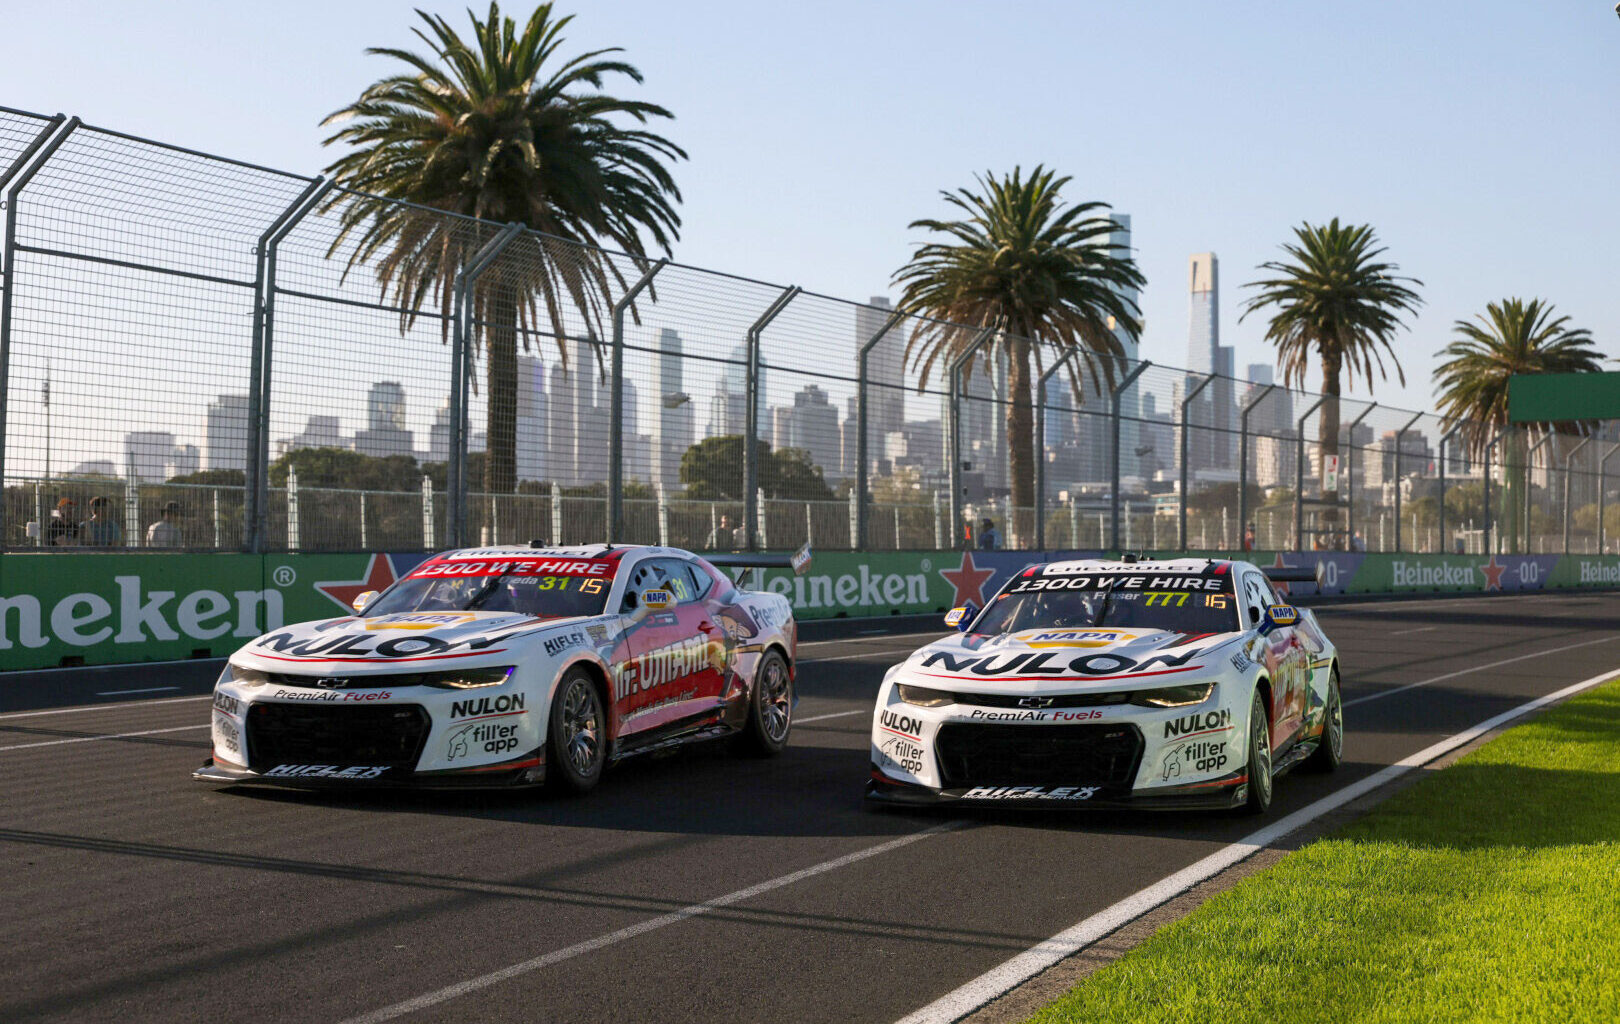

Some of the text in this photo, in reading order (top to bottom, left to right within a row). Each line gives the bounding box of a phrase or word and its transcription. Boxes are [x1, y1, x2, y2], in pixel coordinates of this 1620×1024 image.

[414, 561, 610, 577] 1300 WE HIRE
[1391, 561, 1475, 587] Heineken
[499, 576, 538, 585] Oeda
[539, 576, 571, 591] 31
[672, 578, 689, 600] 31
[731, 564, 930, 609] Heineken
[1010, 576, 1223, 593] 1300 WE HIRE
[646, 592, 667, 603] NAPA
[1093, 591, 1141, 601] Frser
[1143, 592, 1191, 607] 777
[1204, 594, 1226, 609] 16
[1272, 607, 1295, 619] NAPA
[257, 632, 514, 657] NULON
[543, 631, 585, 654] HIFLEX
[1033, 631, 1118, 641] NAPA
[920, 647, 1204, 676] NULON
[274, 689, 392, 702] PremiAir Fuels
[450, 692, 525, 719] NULON
[970, 709, 1103, 722] PremiAir Fuels
[1164, 707, 1231, 739] NULON
[472, 724, 518, 743] fill'er
[483, 737, 519, 755] app
[895, 741, 925, 760] fill'er
[1185, 741, 1227, 761] fill'er
[264, 764, 392, 777] HIFLEX
[901, 758, 923, 775] app
[1195, 754, 1227, 773] app
[964, 786, 1101, 797] HIFLEX
